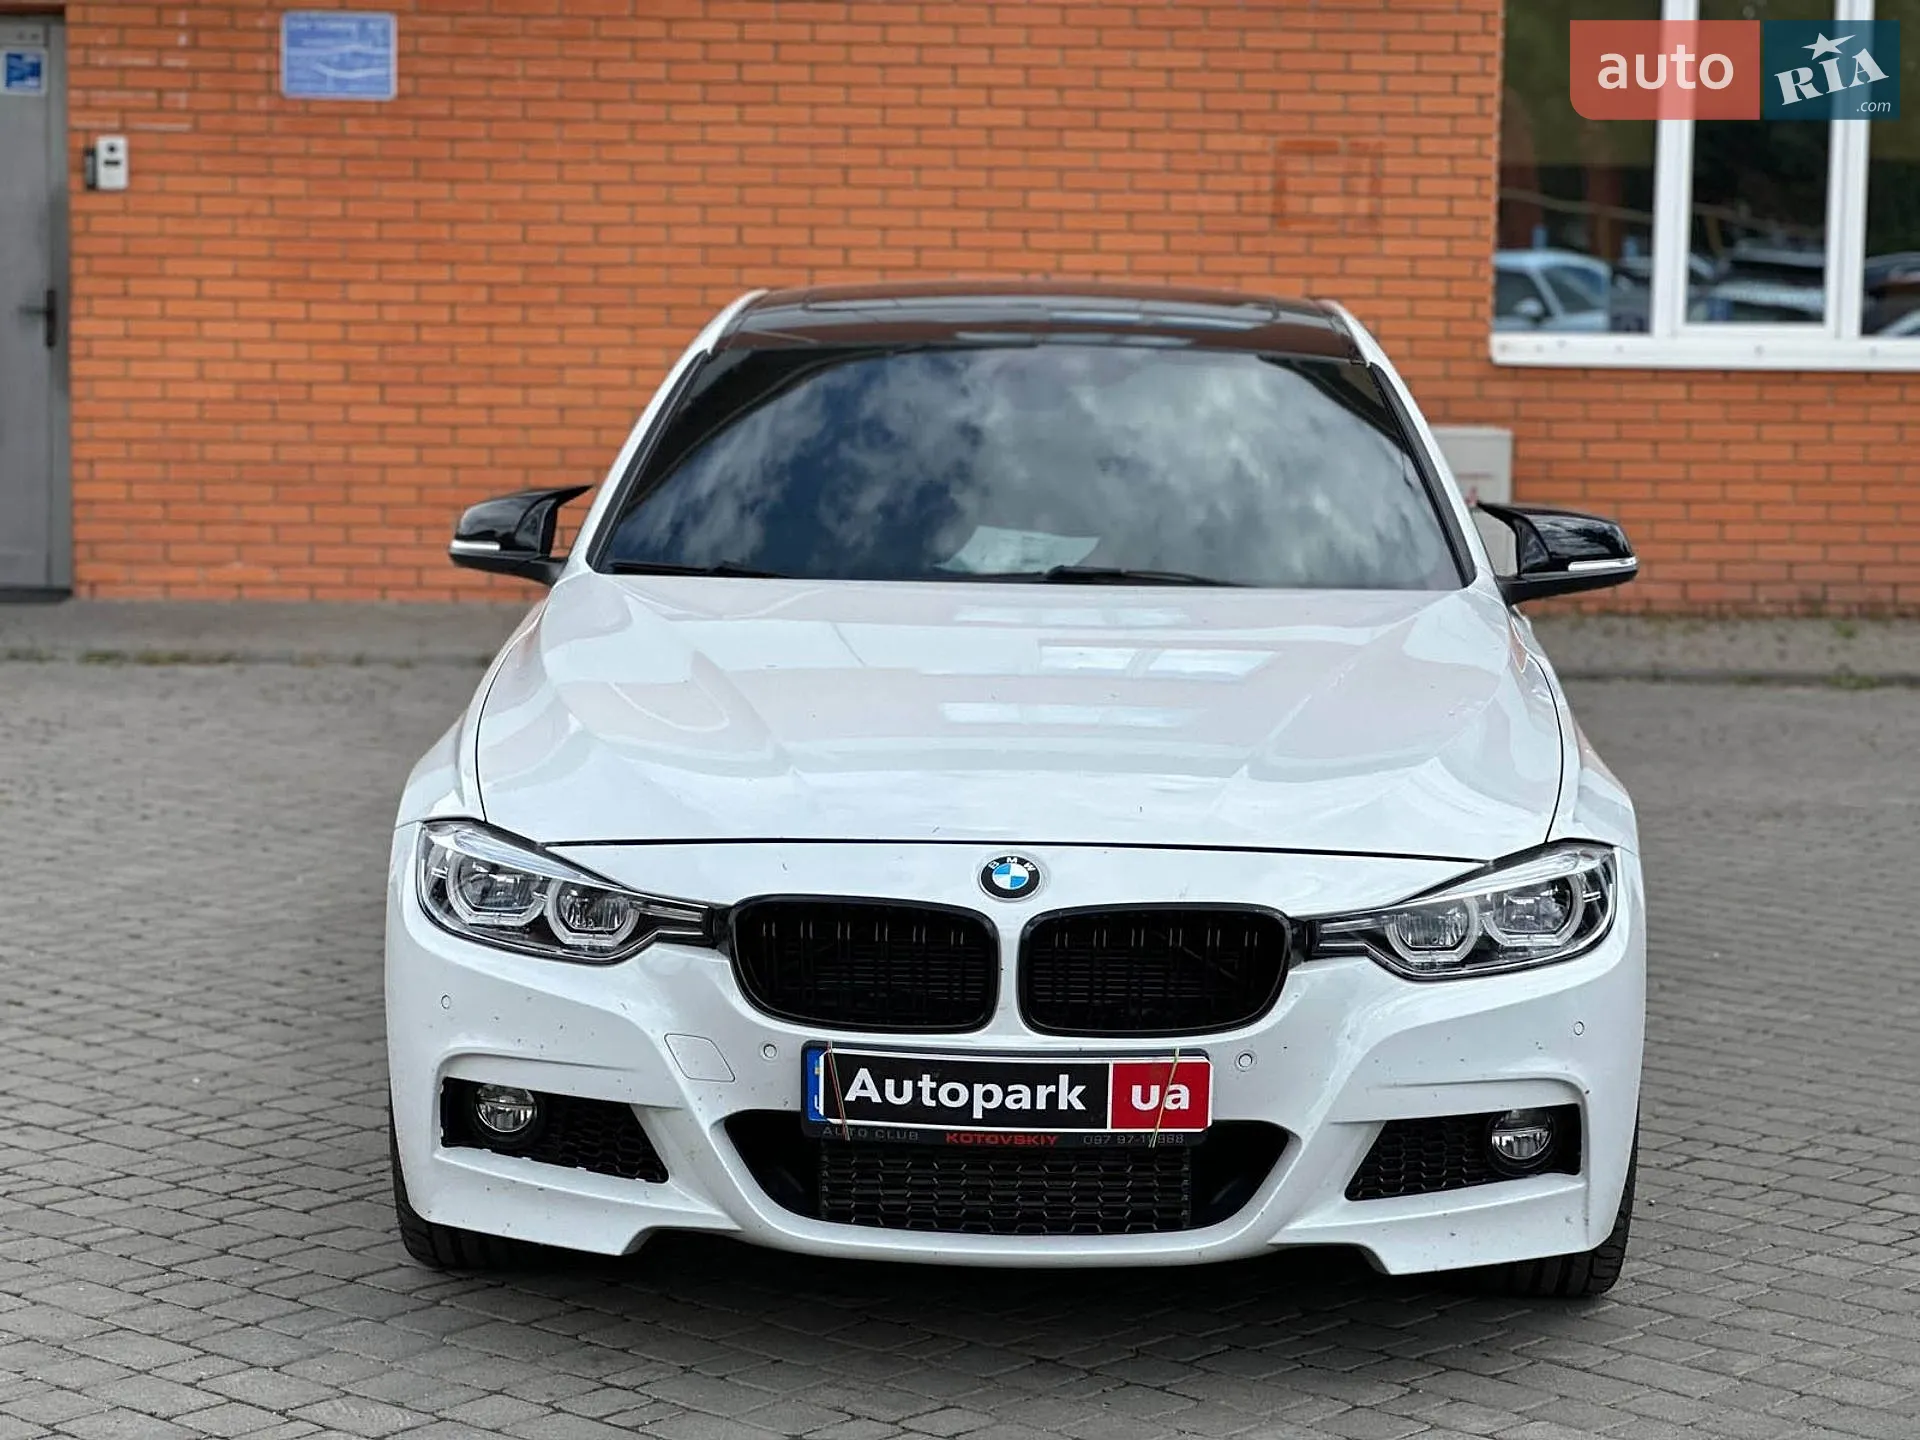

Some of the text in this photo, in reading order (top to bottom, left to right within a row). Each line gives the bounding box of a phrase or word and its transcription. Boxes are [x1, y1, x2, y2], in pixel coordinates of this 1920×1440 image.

[988, 857, 1036, 872] BMW
[844, 1067, 1190, 1119] Autopark ua
[875, 1129, 919, 1141] CLUB
[945, 1132, 1058, 1146] KOTOVSKIY
